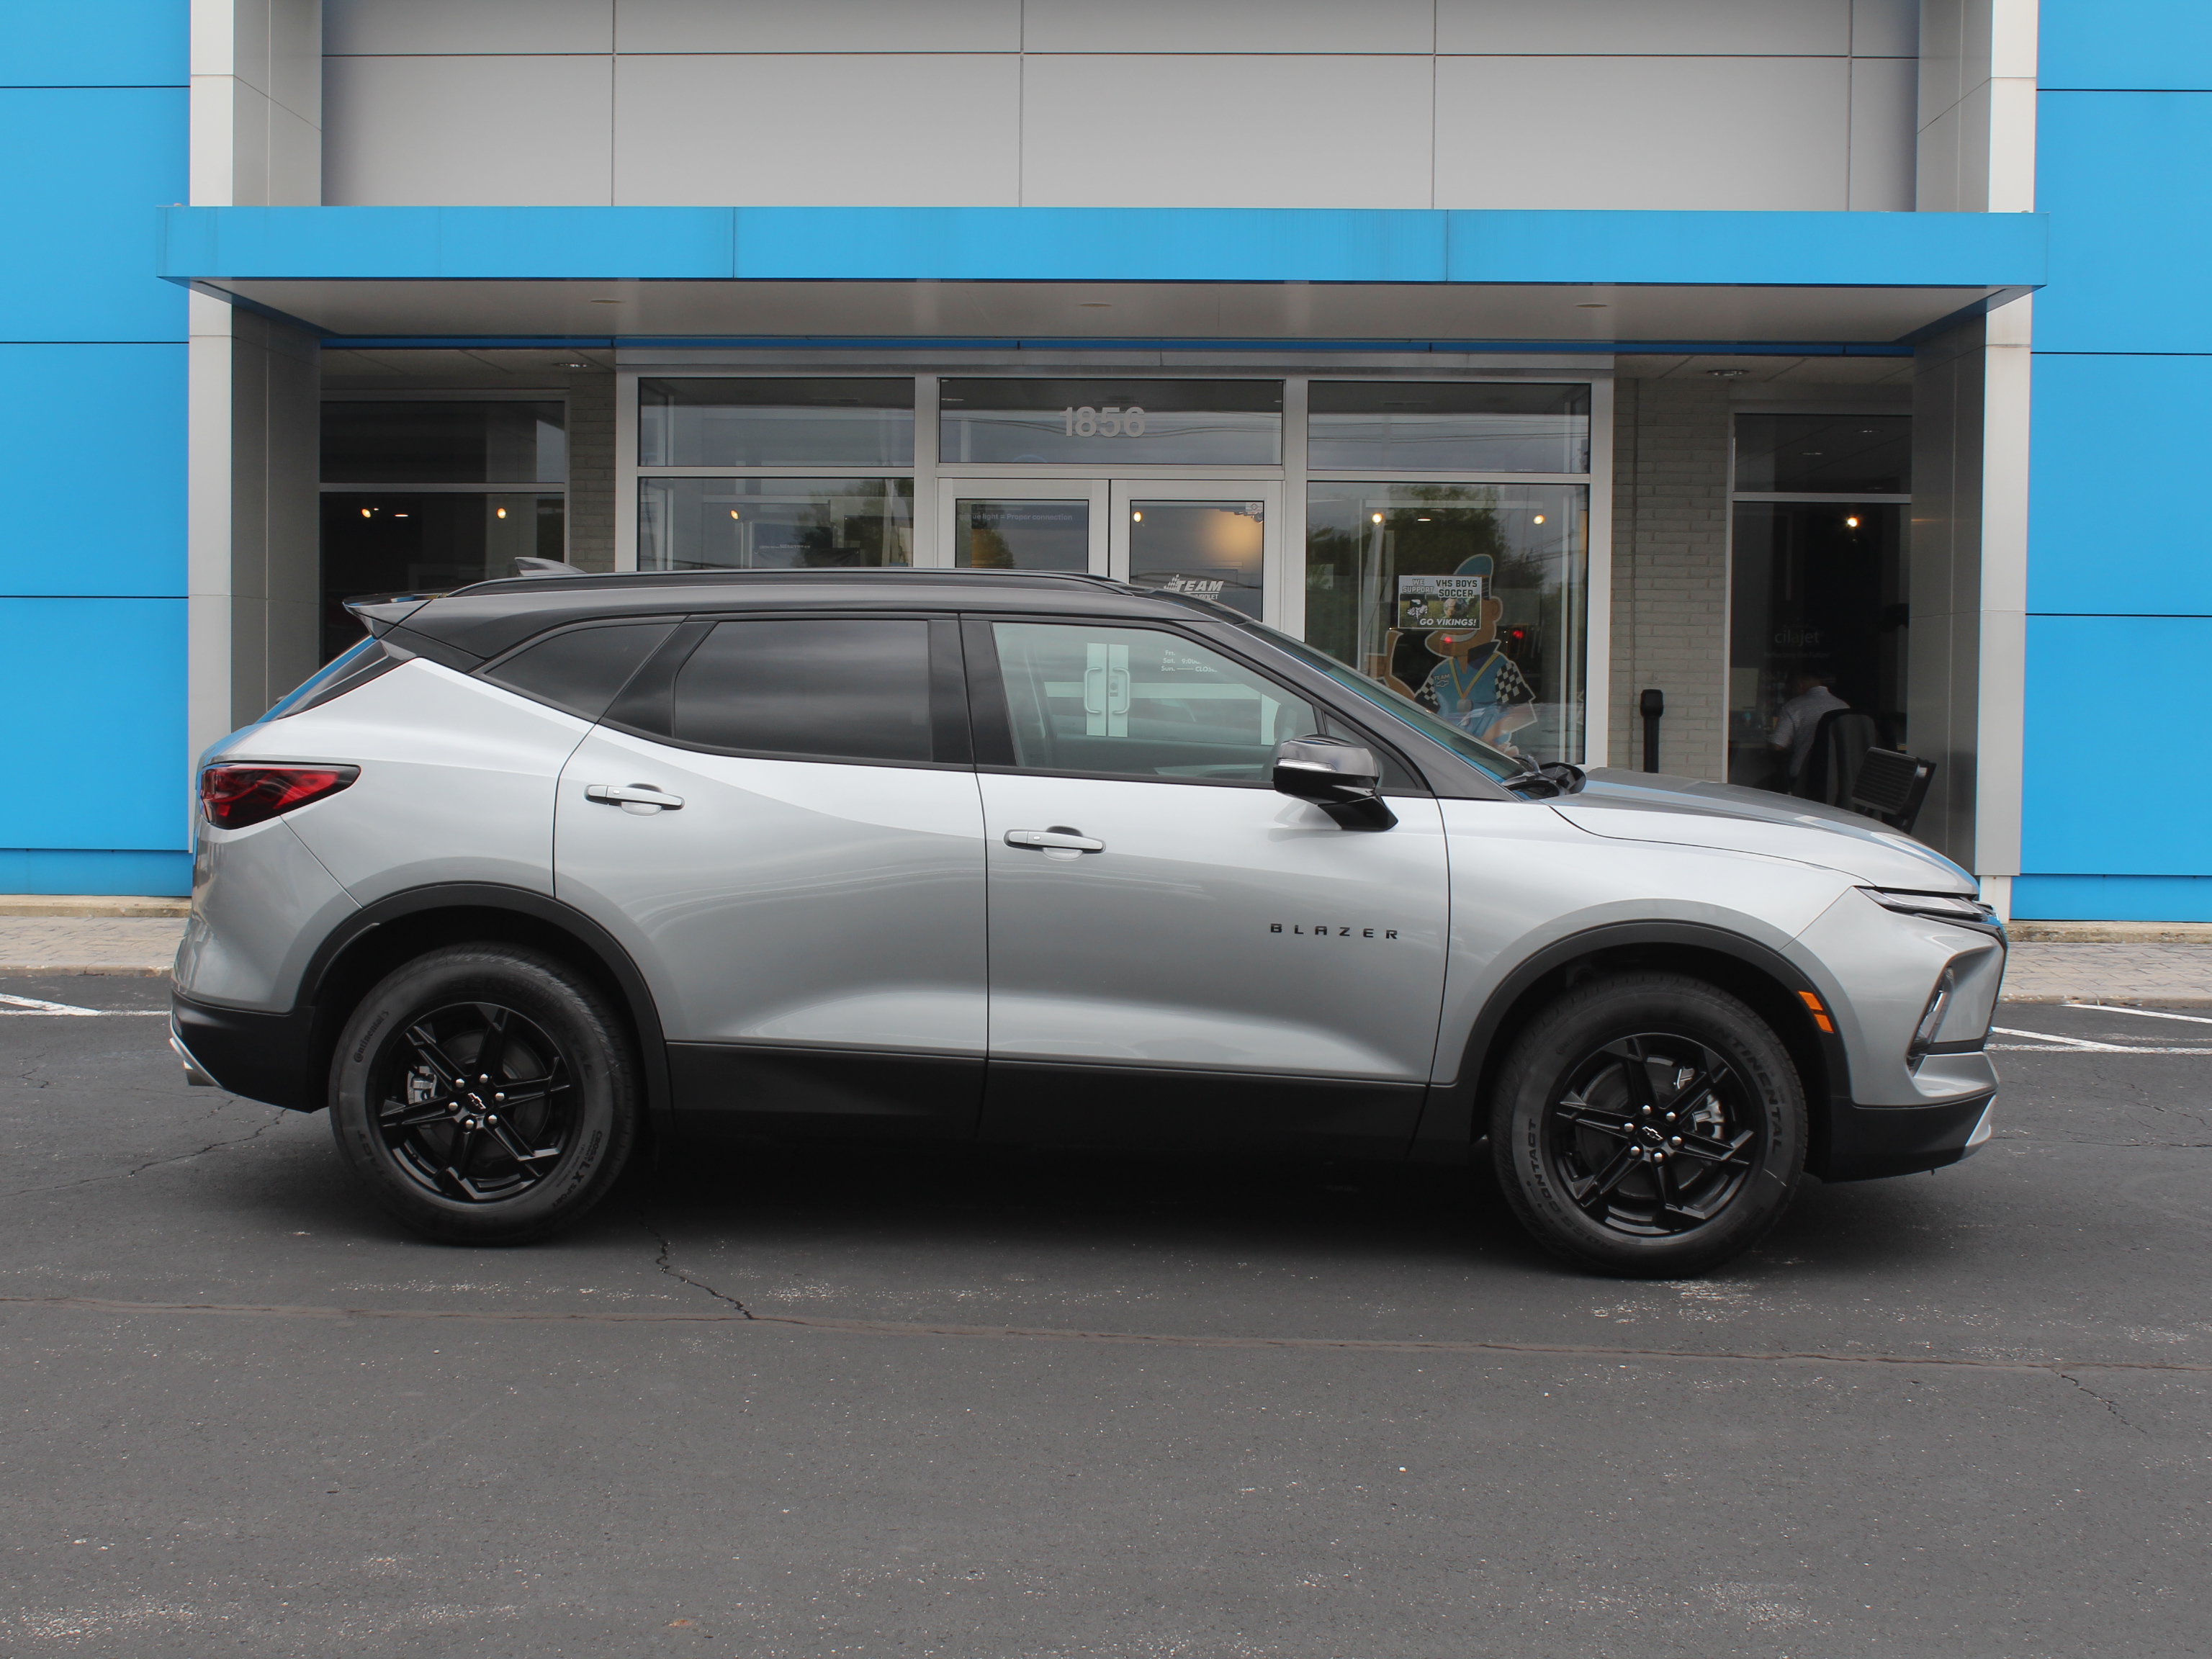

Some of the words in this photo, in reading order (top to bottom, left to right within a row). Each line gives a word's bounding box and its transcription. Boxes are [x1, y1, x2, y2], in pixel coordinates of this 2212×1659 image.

[1060, 406, 1145, 438] 1856
[1175, 580, 1224, 591] TEAM
[1439, 589, 1474, 598] SOCCER
[1774, 629, 1820, 647] cilajet
[1270, 923, 1398, 940] BLAZER
